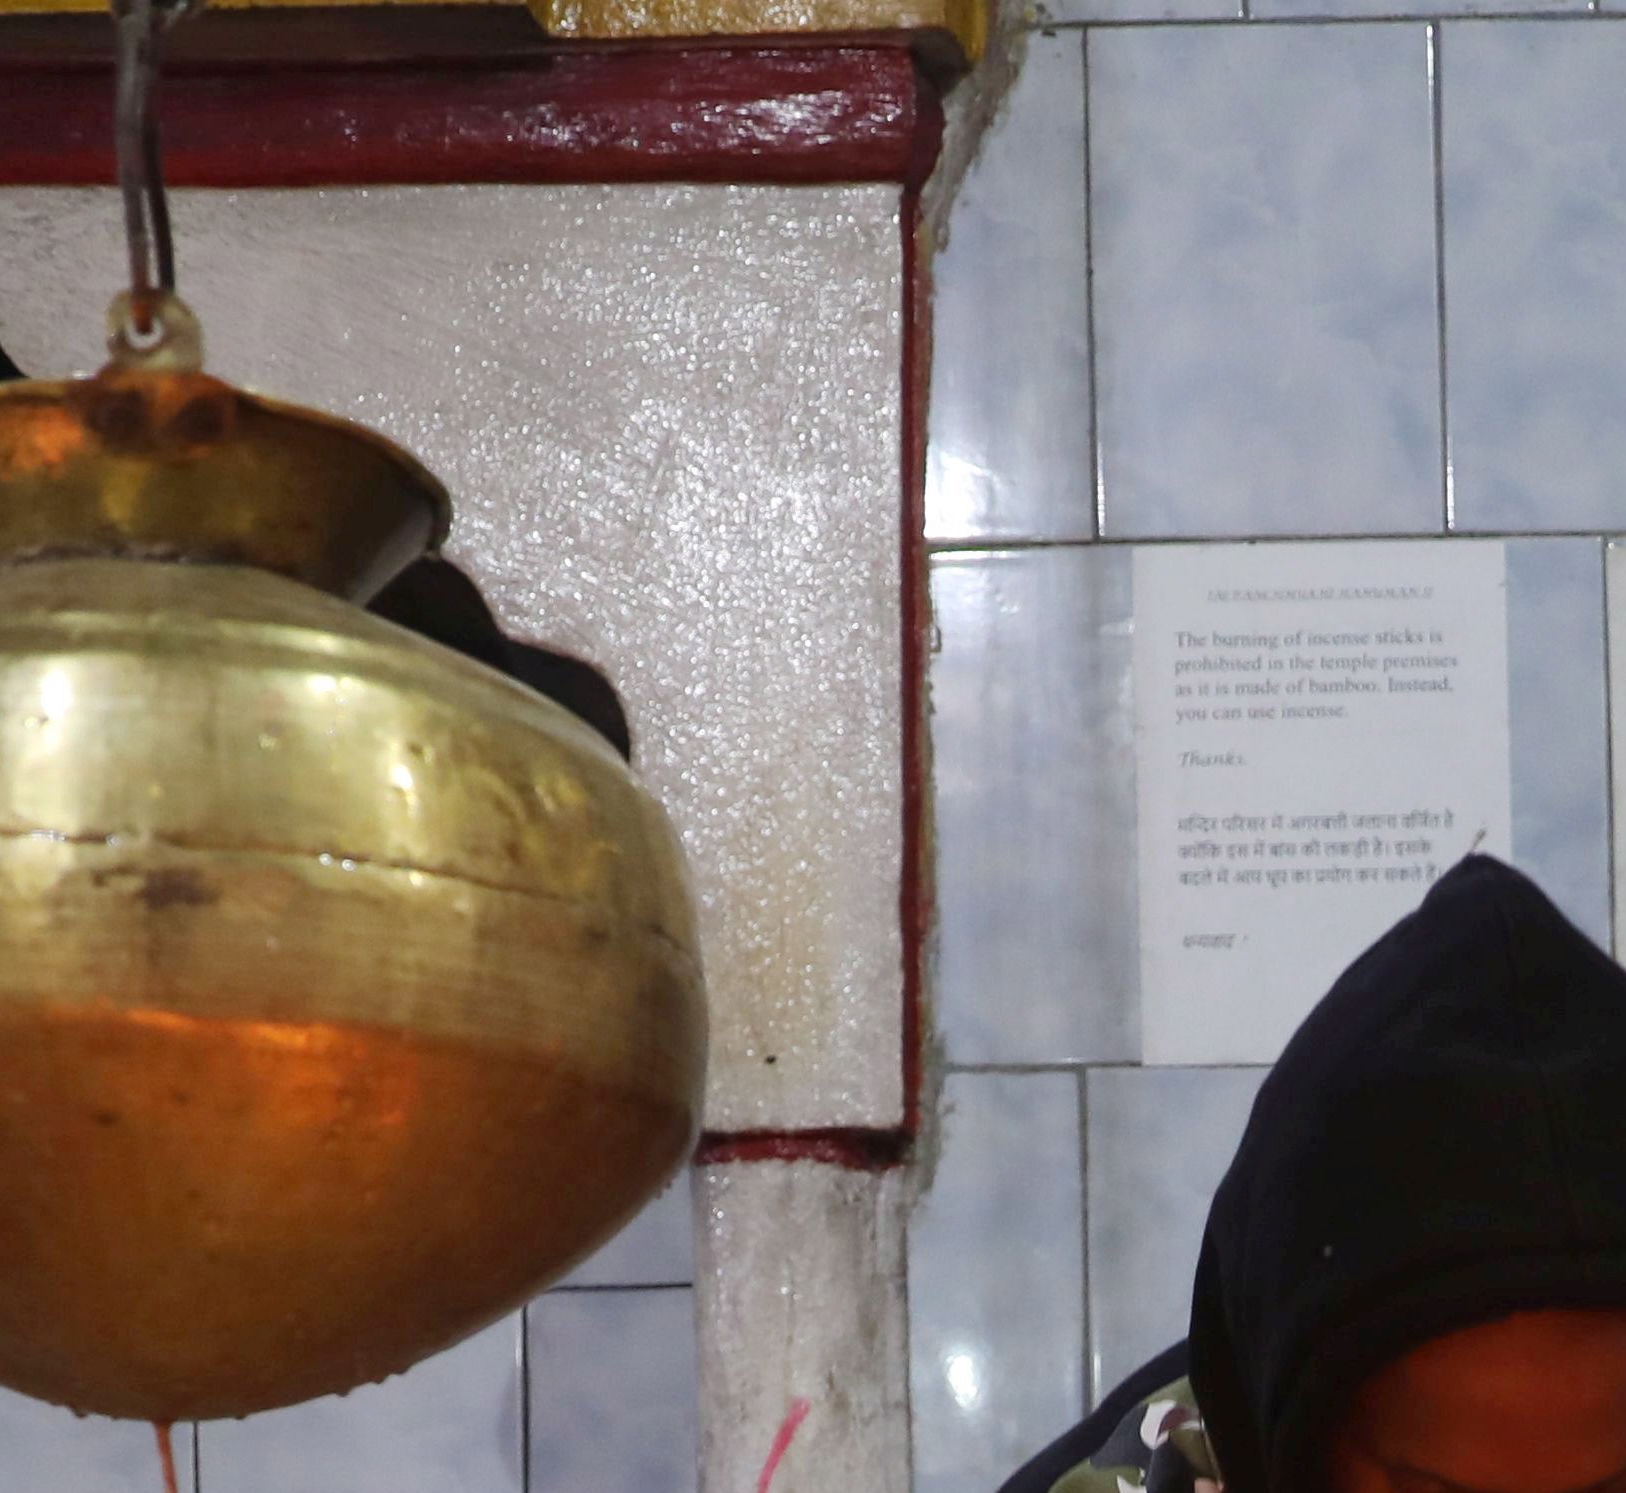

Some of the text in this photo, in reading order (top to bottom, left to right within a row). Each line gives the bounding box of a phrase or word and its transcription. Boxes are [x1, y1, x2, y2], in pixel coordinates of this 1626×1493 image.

[1177, 631, 1208, 649] The
[1212, 630, 1281, 651] burning
[1307, 632, 1371, 647] incense
[1375, 628, 1425, 645] sticks
[1174, 654, 1263, 677] prohibited
[1289, 653, 1316, 672] the
[1320, 653, 1379, 674] temple
[1382, 651, 1458, 674] premises
[1234, 677, 1281, 696] made
[1308, 676, 1381, 694] bamboo.
[1176, 708, 1209, 725] you
[1212, 707, 1243, 720] can
[1247, 706, 1277, 720] use
